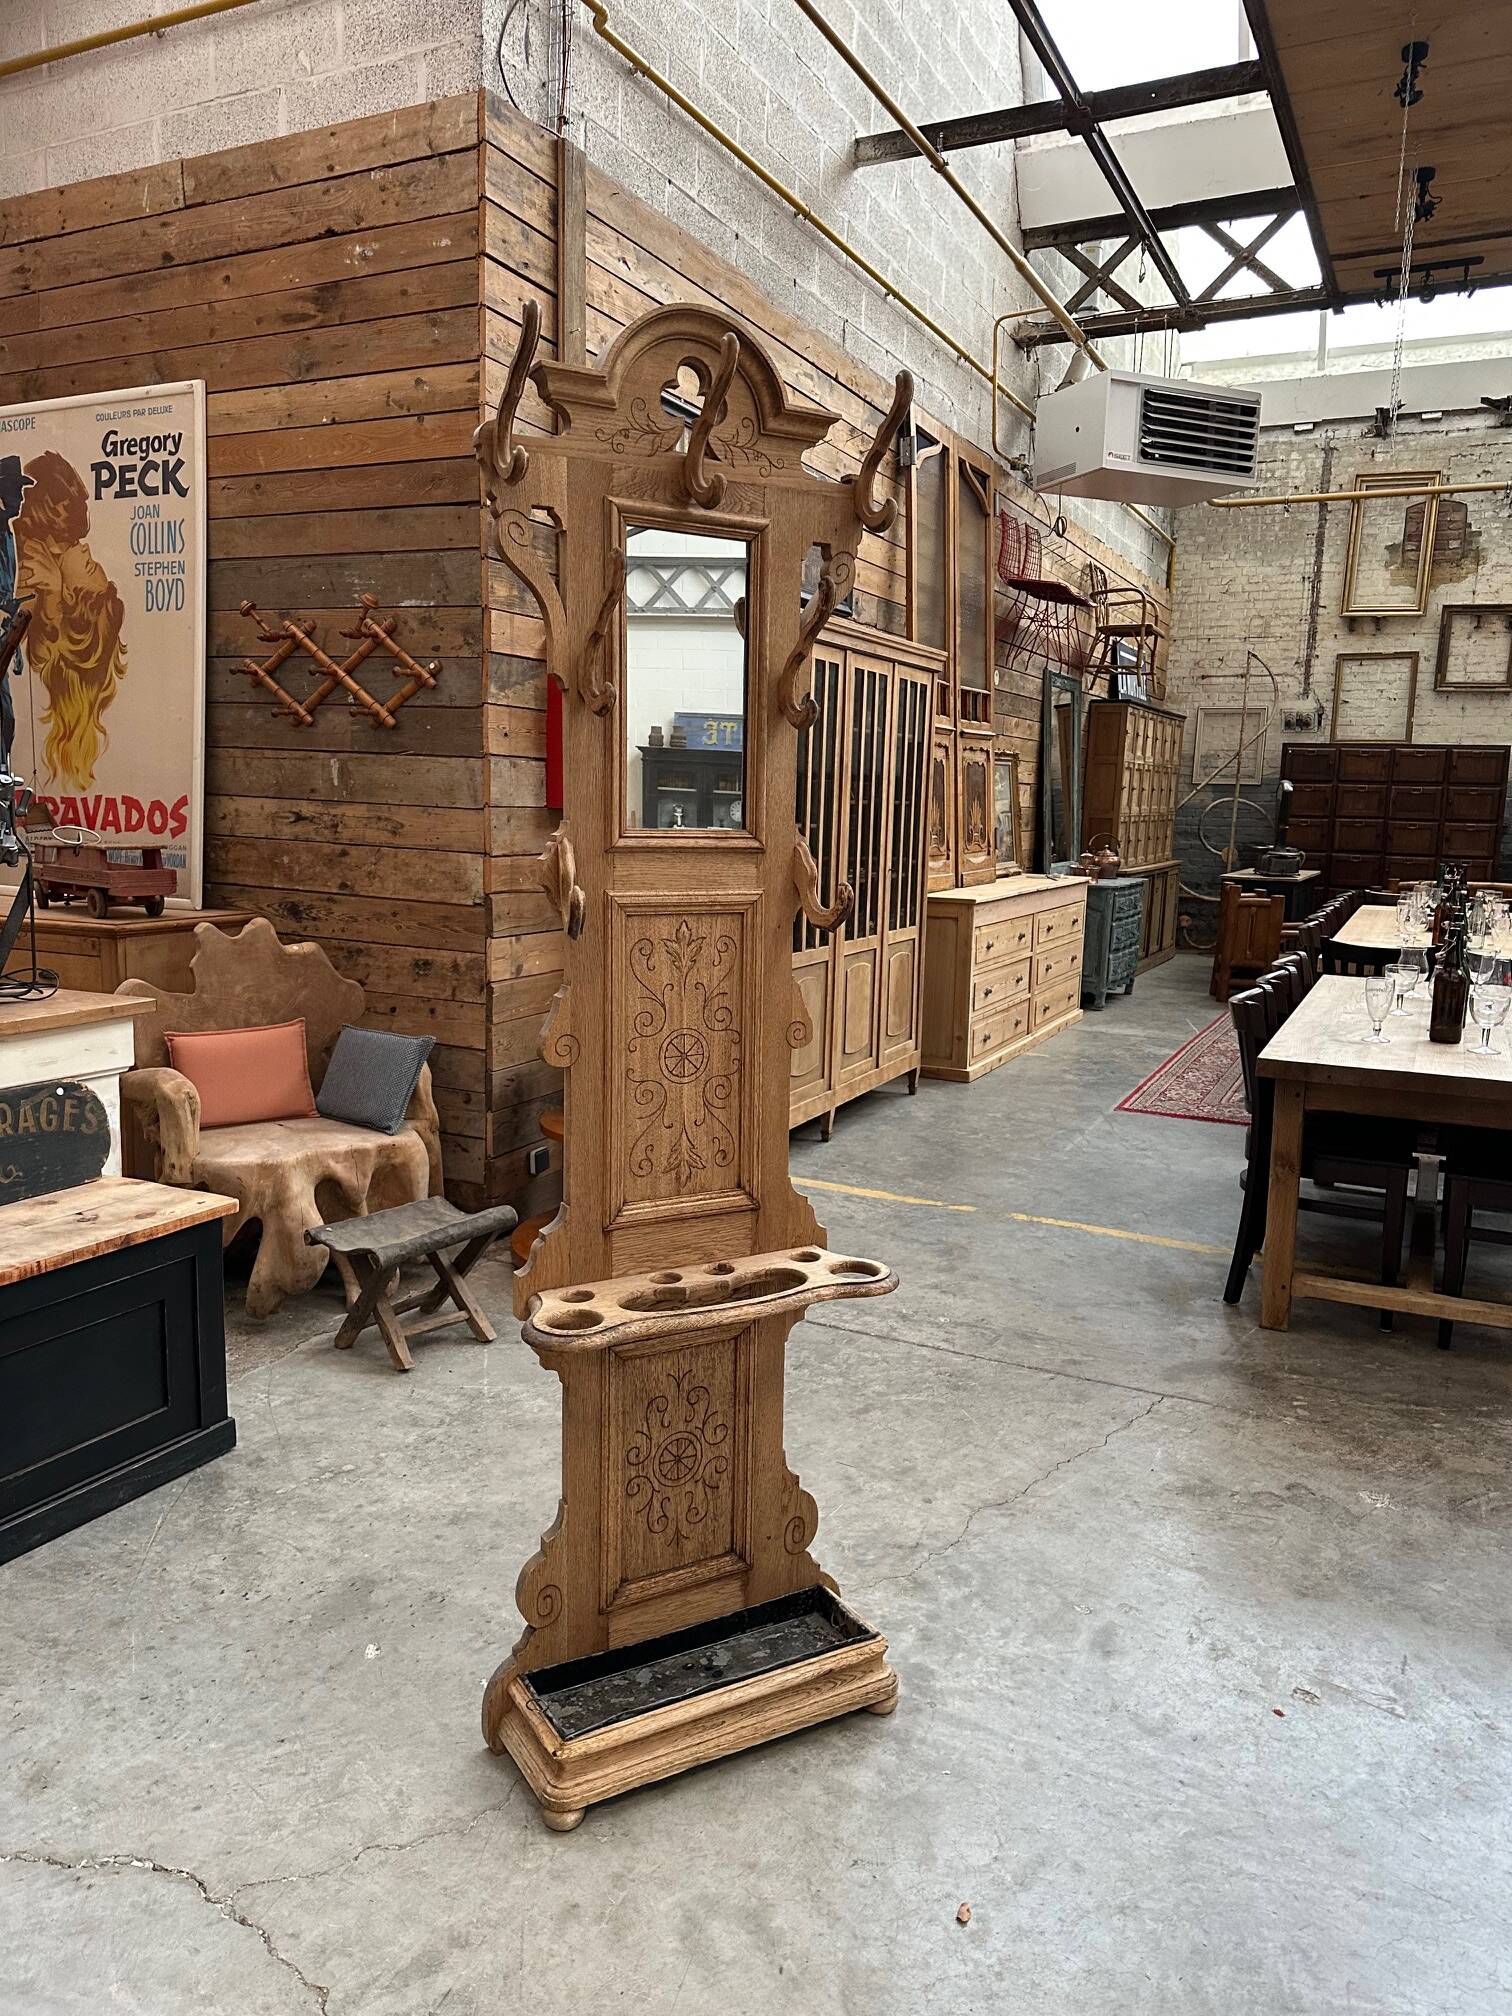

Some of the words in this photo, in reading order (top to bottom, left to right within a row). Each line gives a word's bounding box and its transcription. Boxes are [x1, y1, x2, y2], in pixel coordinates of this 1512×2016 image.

[95, 409, 132, 422] COULEURS
[132, 408, 147, 417] PAR
[148, 404, 173, 416] DELUXE
[101, 429, 183, 461] Gregory
[90, 457, 191, 501] PECK
[130, 503, 160, 521] JOAN
[130, 518, 186, 556] COLLINS
[134, 560, 186, 577] STEPHEN
[145, 578, 185, 613] BOYD
